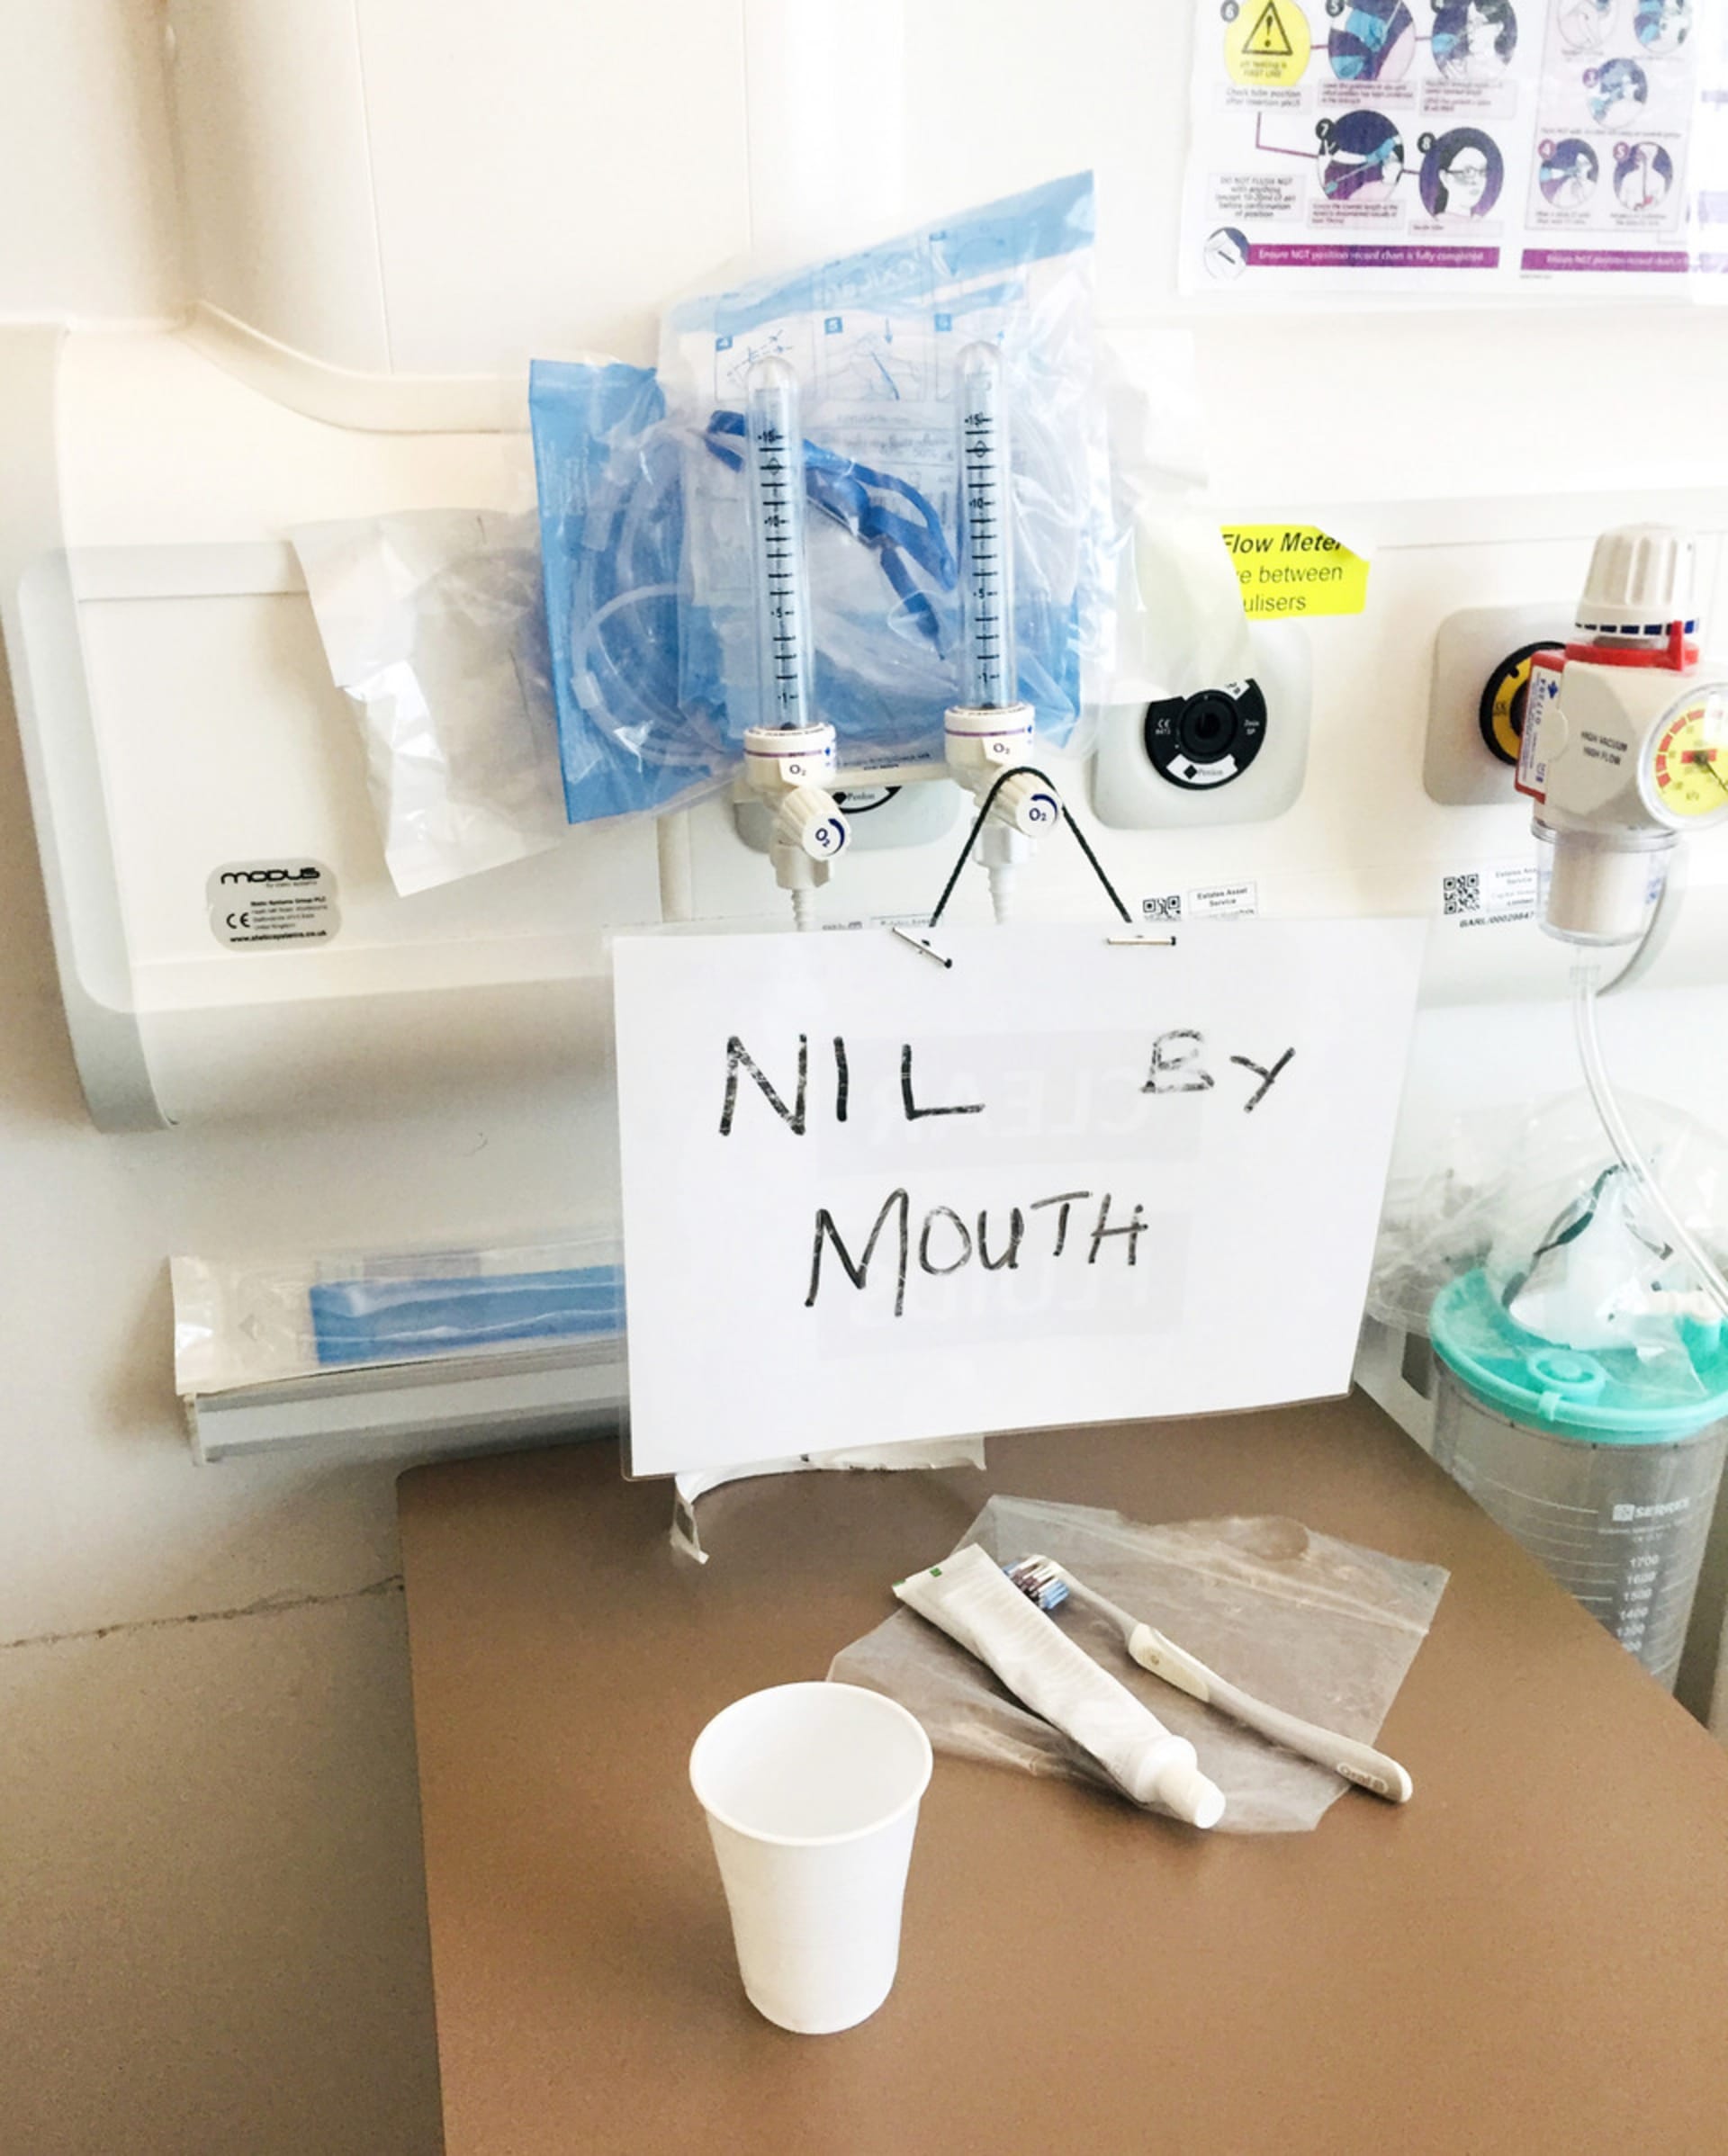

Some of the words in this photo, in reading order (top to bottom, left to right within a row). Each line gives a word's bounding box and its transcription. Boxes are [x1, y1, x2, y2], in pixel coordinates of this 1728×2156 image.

[1291, 249, 1310, 260] NGT
[1312, 250, 1348, 262] position
[1222, 533, 1274, 554] Flow
[1236, 569, 1252, 585] e
[1259, 566, 1343, 584] between
[1029, 807, 1048, 822] O2
[815, 827, 831, 849] O2
[1197, 891, 1225, 901] Estates
[1227, 887, 1248, 895] Asset
[1209, 898, 1237, 908] Service
[719, 1032, 985, 1137] NIL
[804, 1187, 1149, 1317] MOUTH
[1630, 1554, 1660, 1568] 1700
[1627, 1570, 1658, 1585] 1600
[1624, 1587, 1653, 1602] 1500
[1620, 1606, 1649, 1621] 1400
